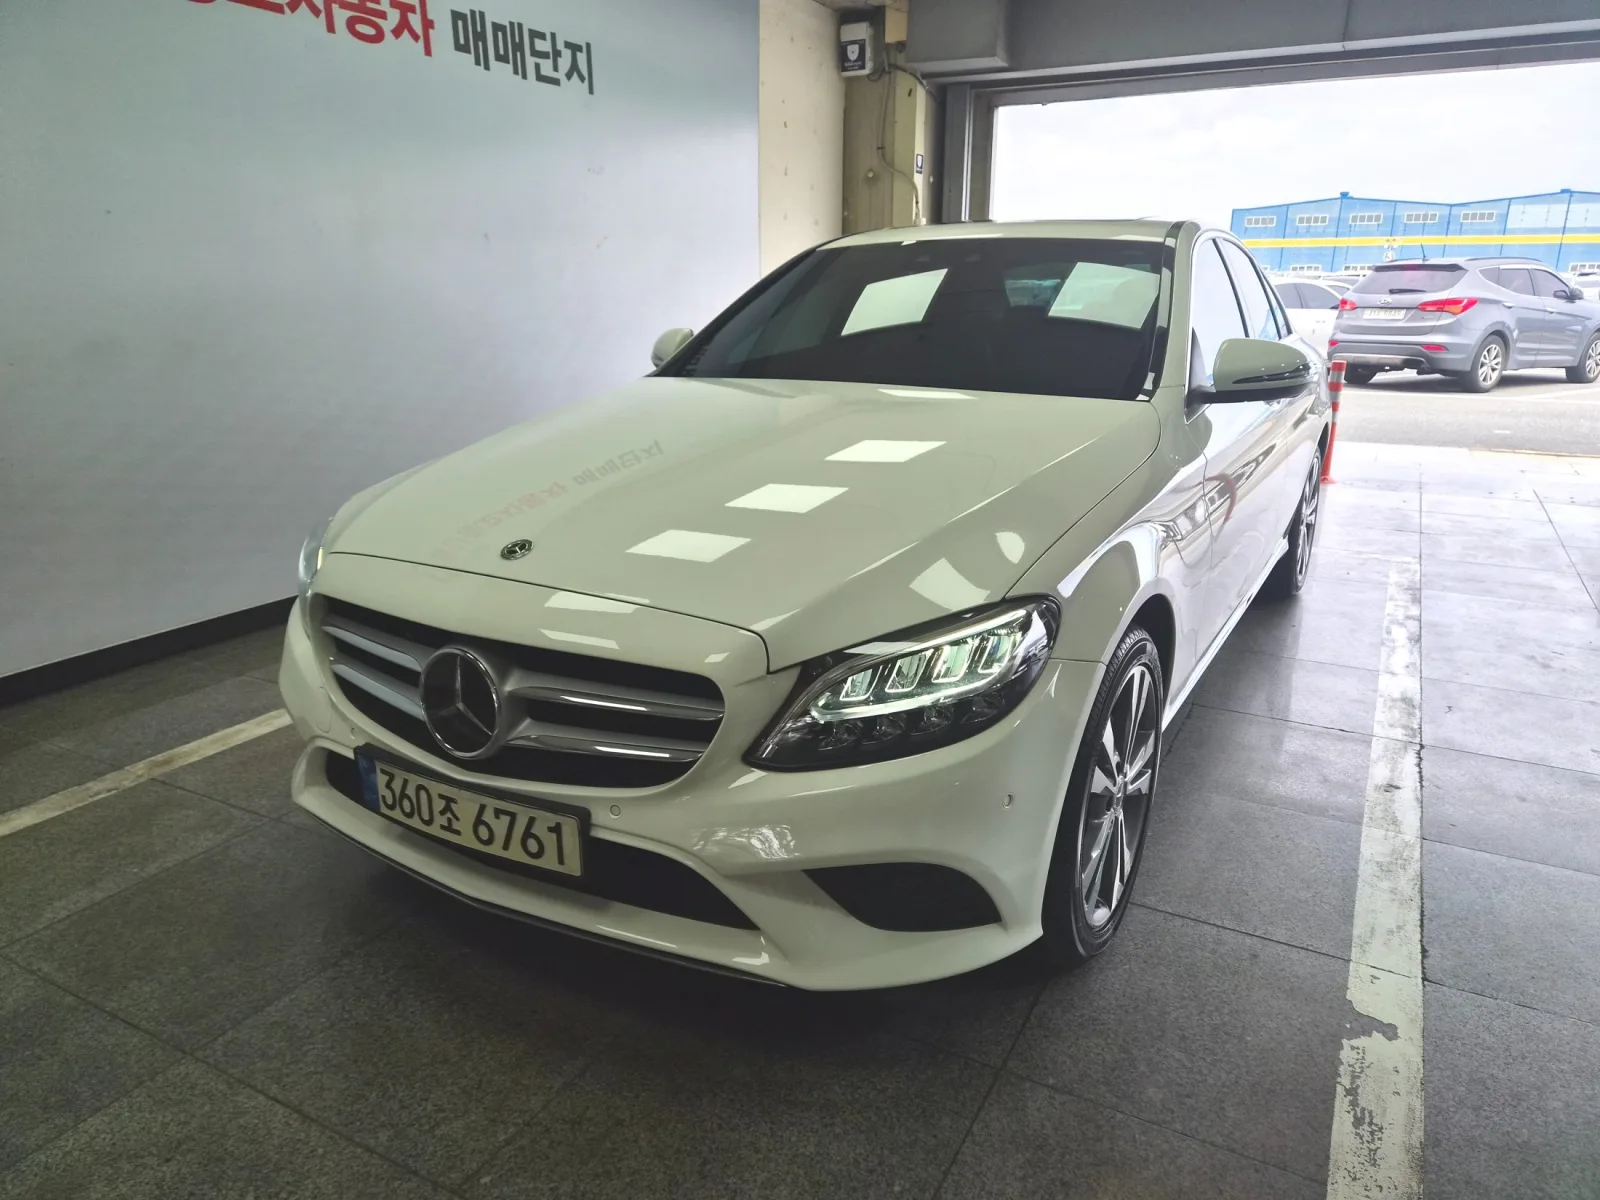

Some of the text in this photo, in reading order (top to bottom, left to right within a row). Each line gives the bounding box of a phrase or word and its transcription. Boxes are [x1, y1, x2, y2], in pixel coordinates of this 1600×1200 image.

[188, 0, 595, 96] 자동차 매매단지
[379, 767, 565, 866] 360조 6761
